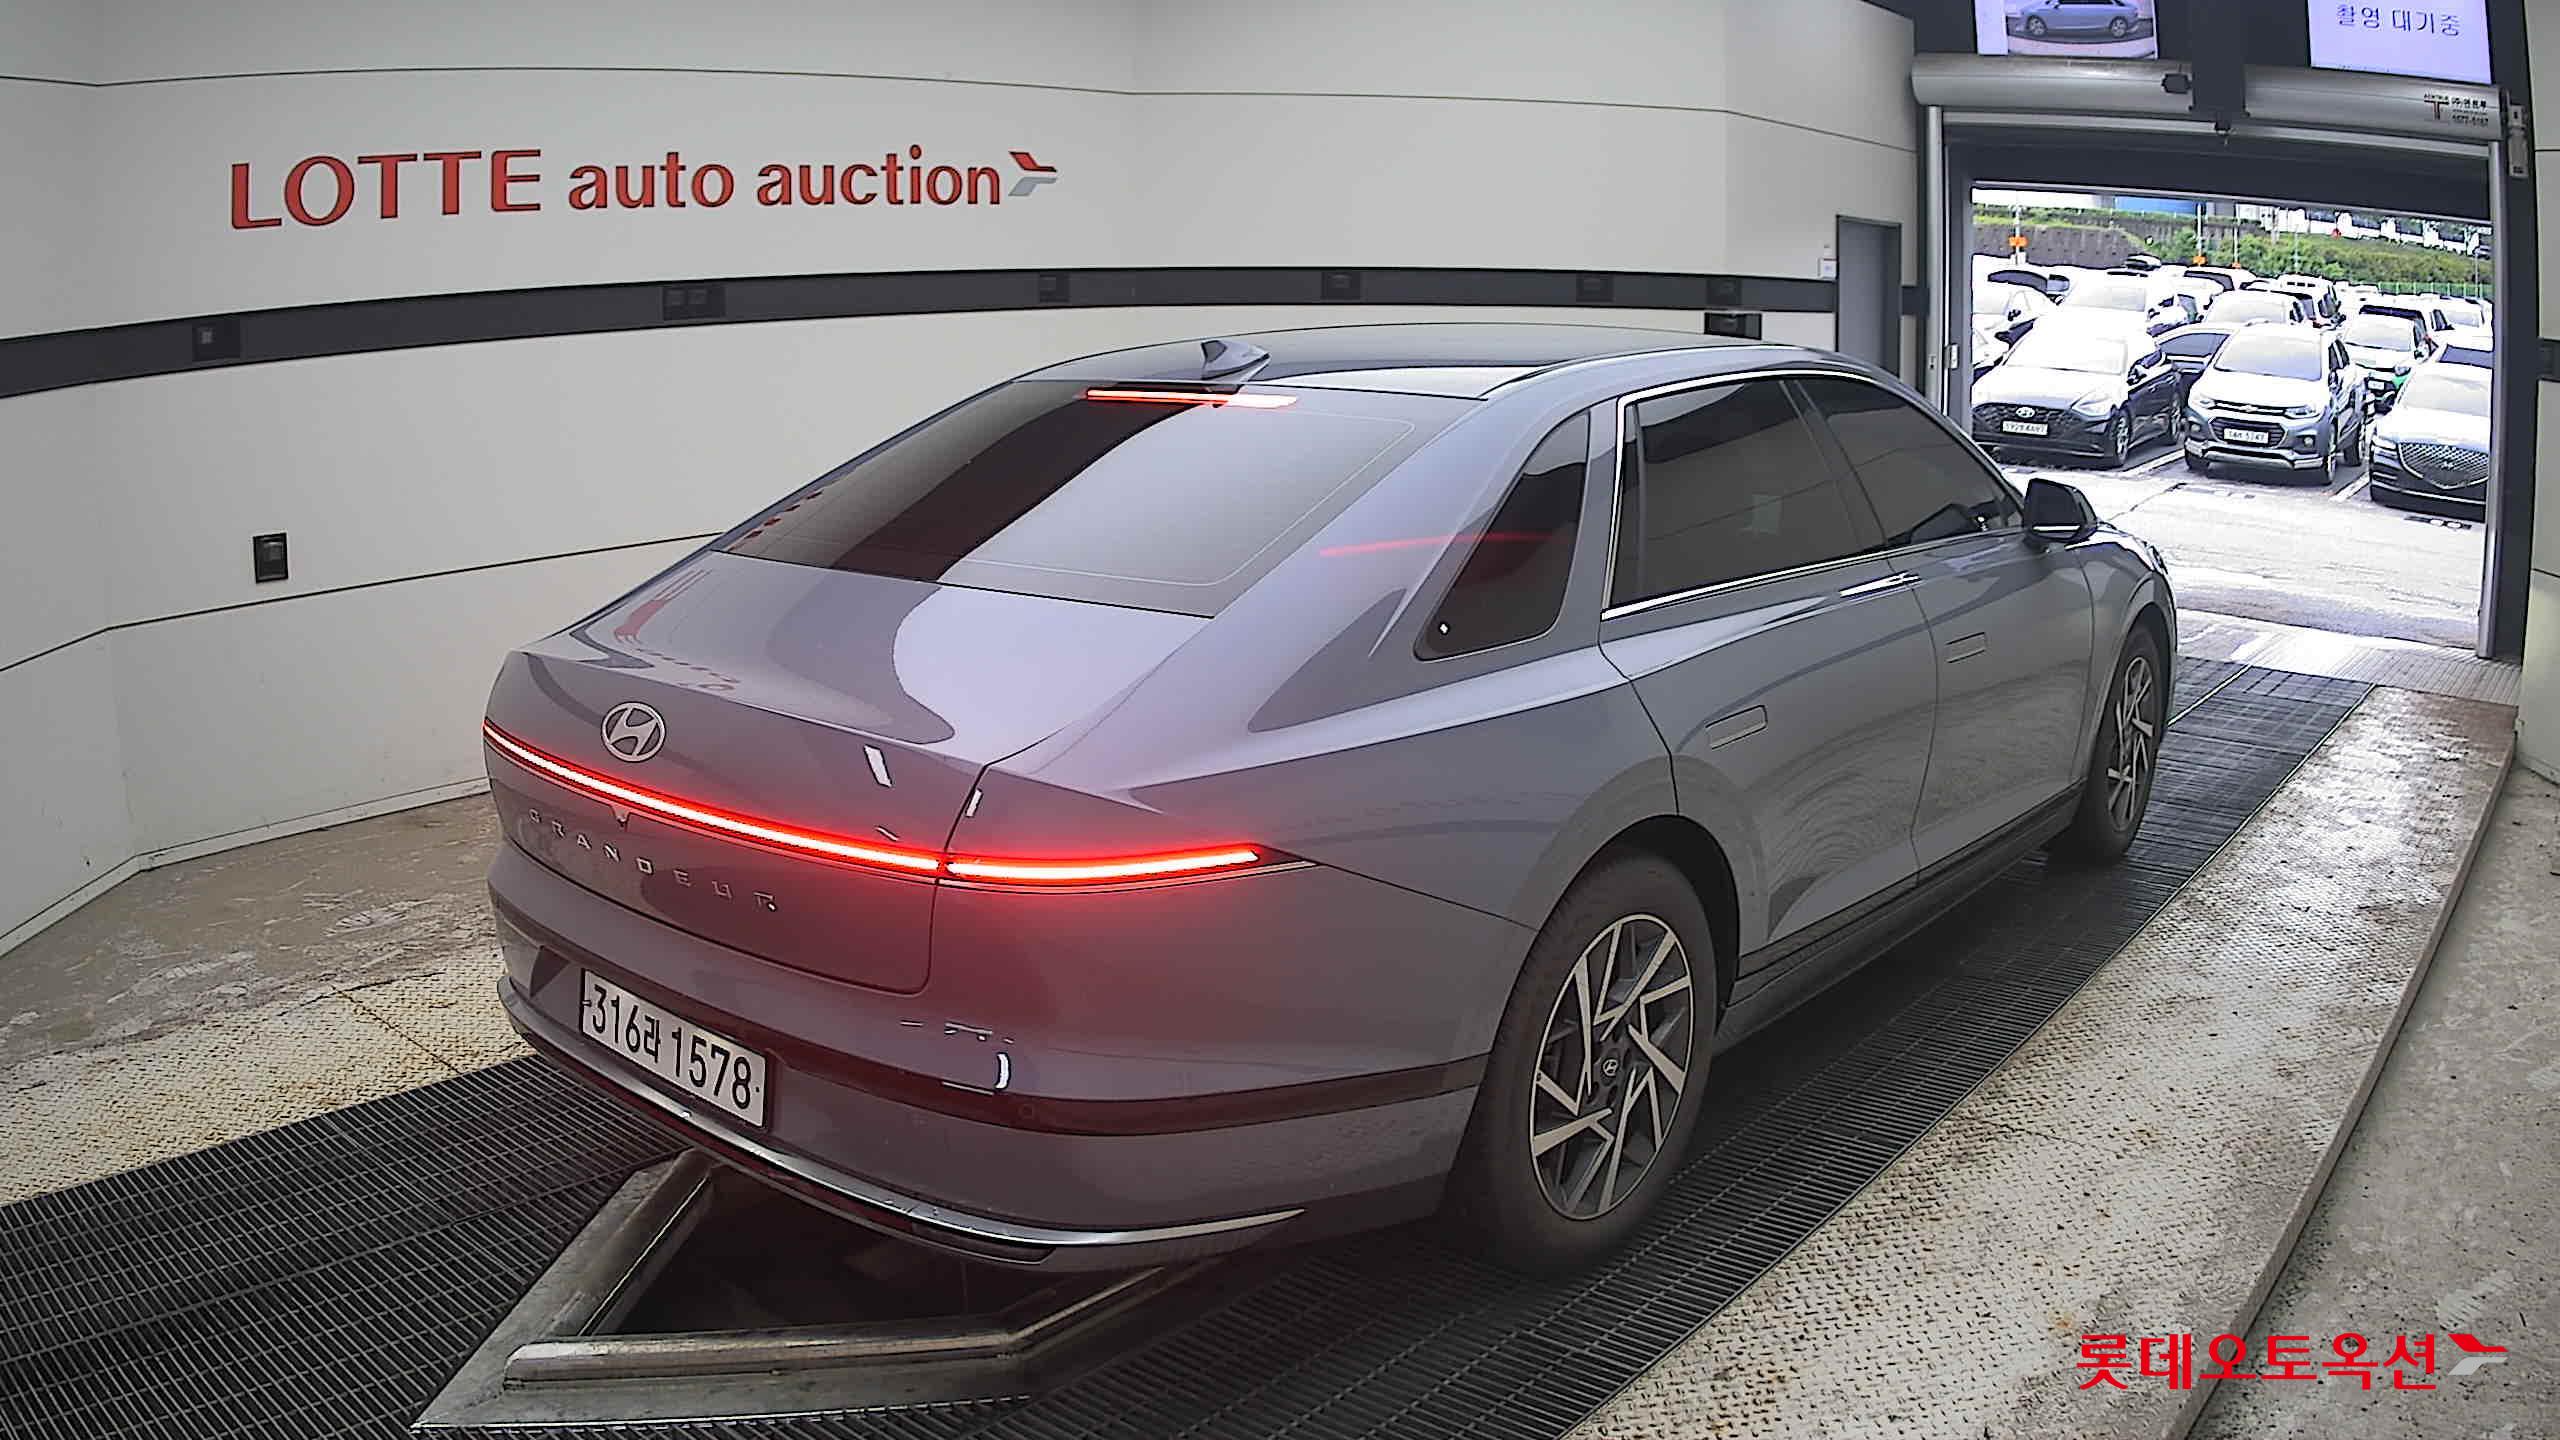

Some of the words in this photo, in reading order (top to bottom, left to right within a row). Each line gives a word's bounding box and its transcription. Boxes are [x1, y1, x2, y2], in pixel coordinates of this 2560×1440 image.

[2337, 5, 2380, 29] 촬영
[2392, 9, 2459, 36] 대기중
[231, 150, 542, 230] LOTTE
[568, 152, 735, 209] auto
[756, 145, 1002, 207] auction
[527, 808, 778, 912] GRANDEUR
[671, 1026, 752, 1110] 1578
